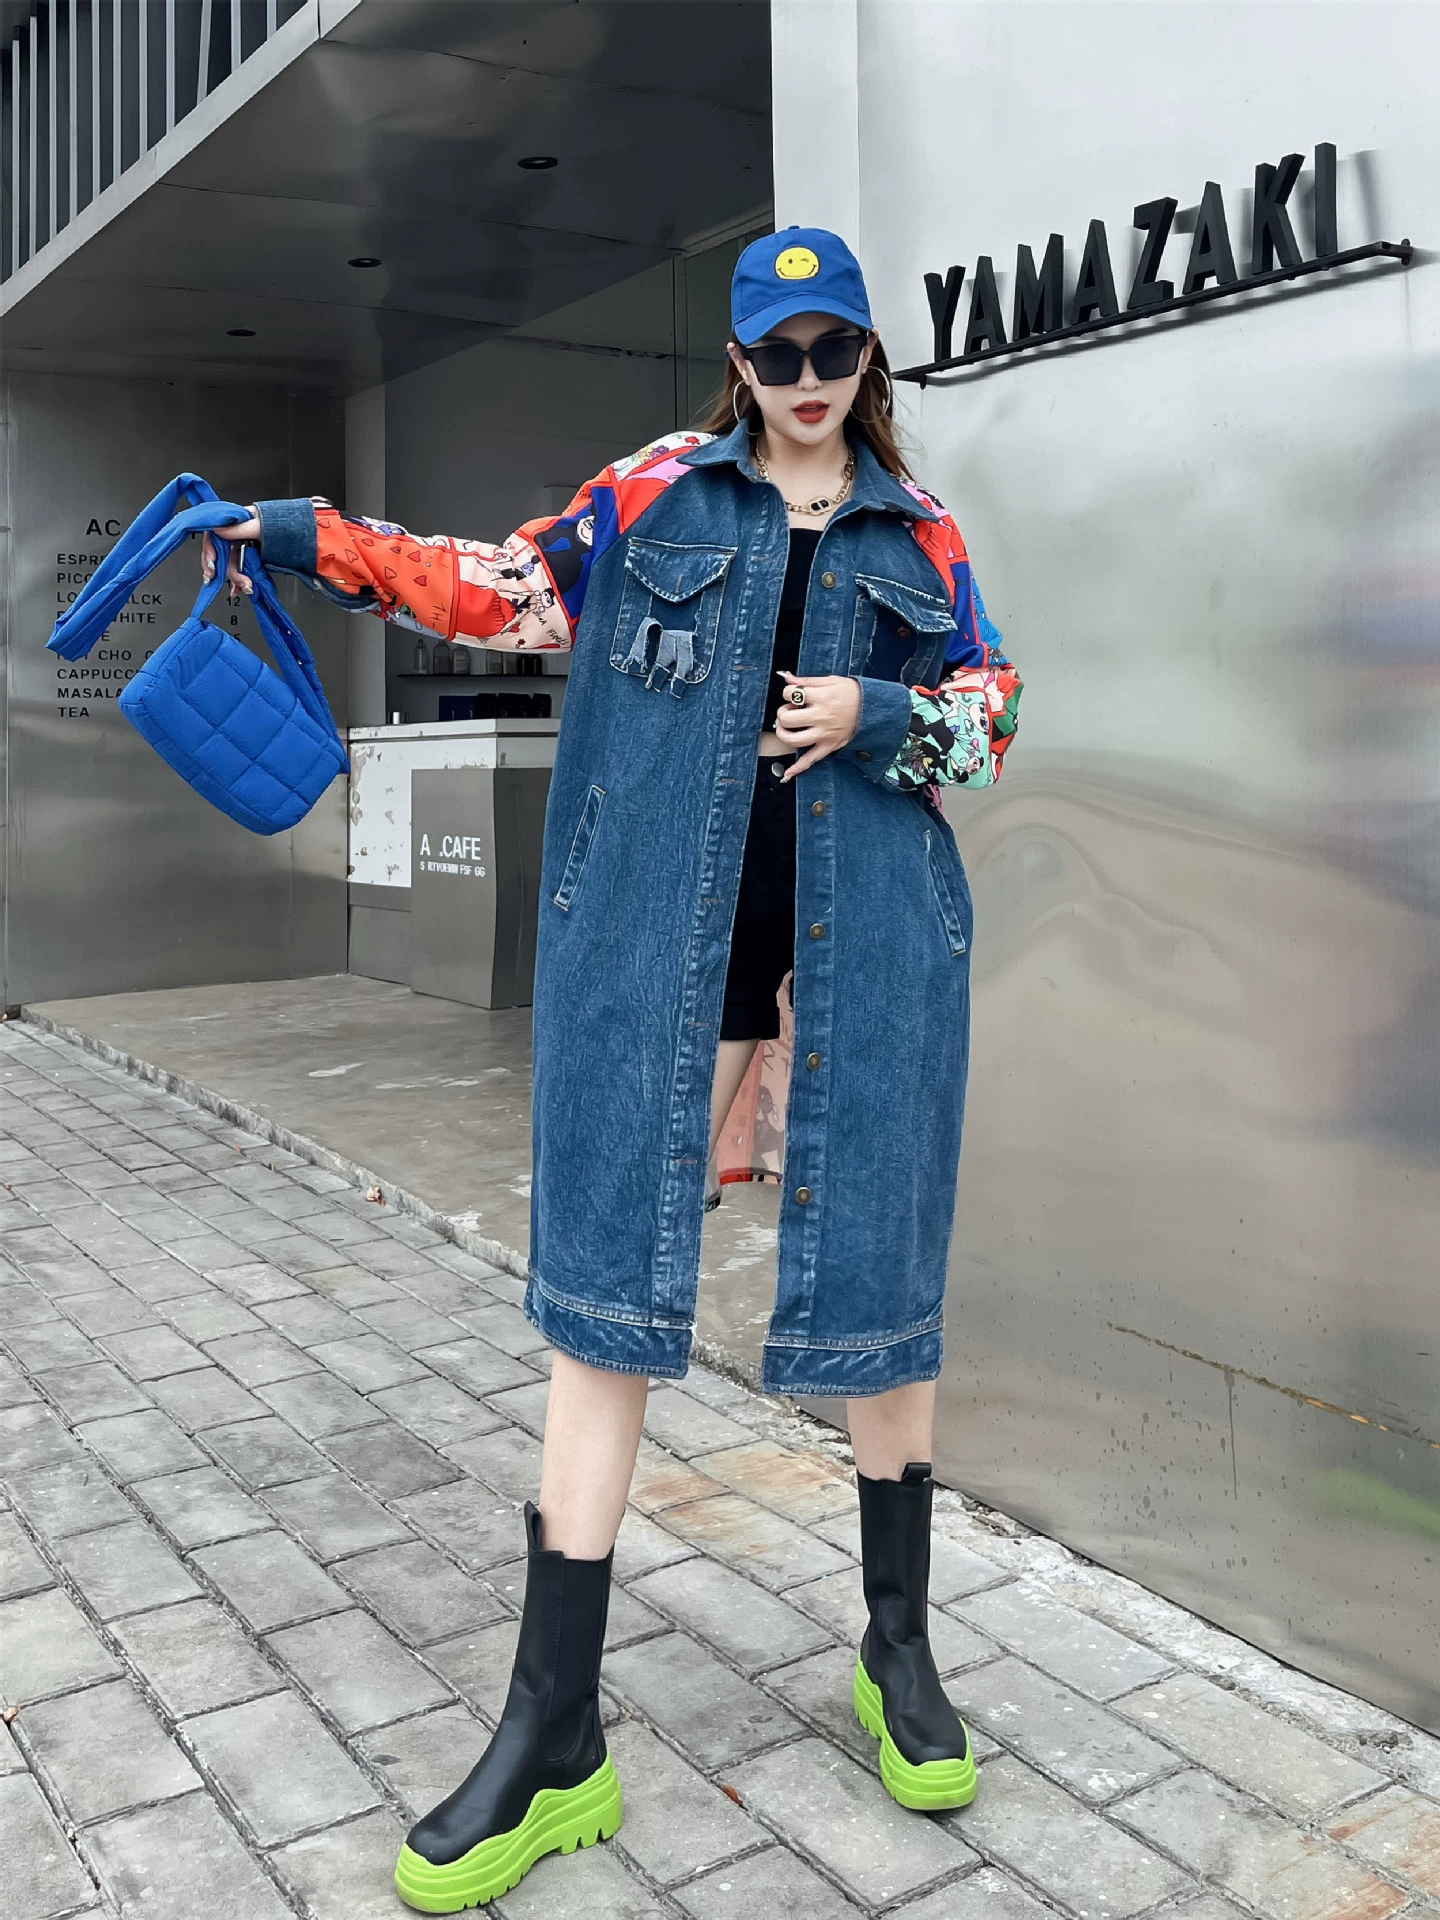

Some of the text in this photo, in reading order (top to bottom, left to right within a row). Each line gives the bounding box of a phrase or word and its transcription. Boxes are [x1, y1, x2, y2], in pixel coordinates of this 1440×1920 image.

[923, 142, 1337, 362] YAMAZAKI
[225, 597, 241, 607] 12
[114, 612, 238, 626] HITE 8
[98, 650, 132, 661] CHO
[57, 668, 140, 680] CAPPUCC
[57, 706, 90, 717] TEA
